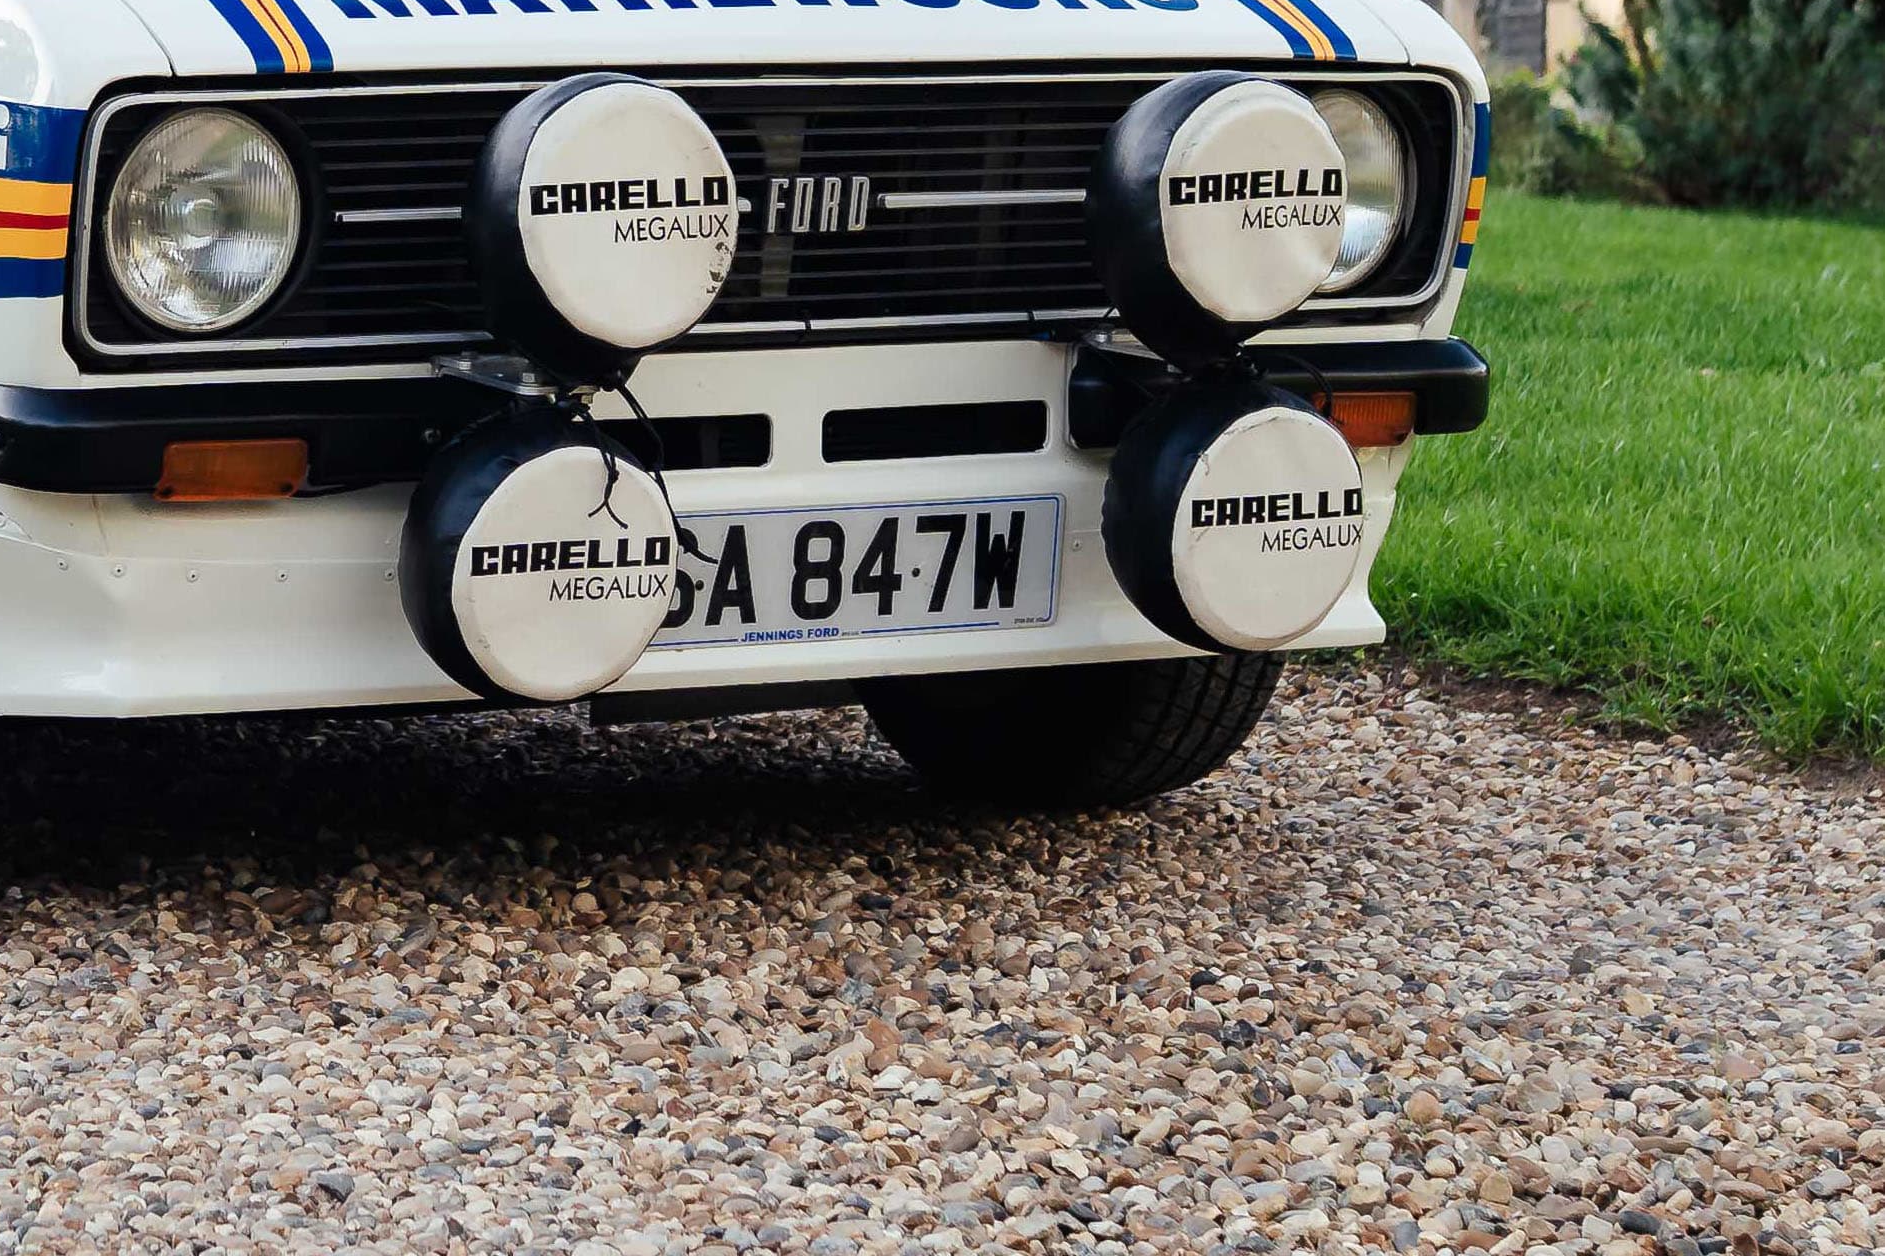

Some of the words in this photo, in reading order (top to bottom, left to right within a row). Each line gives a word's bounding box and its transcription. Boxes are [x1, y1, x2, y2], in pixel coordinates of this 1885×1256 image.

[530, 175, 730, 216] CARELLO
[766, 176, 872, 234] FORD
[1168, 168, 1343, 206] CARELLO
[614, 214, 731, 243] MEGALUX
[1241, 203, 1343, 230] MEGALUX
[1191, 487, 1363, 528] CARELLO
[470, 536, 671, 577] CARELLO
[1262, 524, 1363, 553] MEGALUX
[790, 510, 1027, 621] 847W
[549, 574, 669, 602] MEGALUX
[741, 630, 804, 642] JENNINGS
[807, 627, 840, 638] FORD
